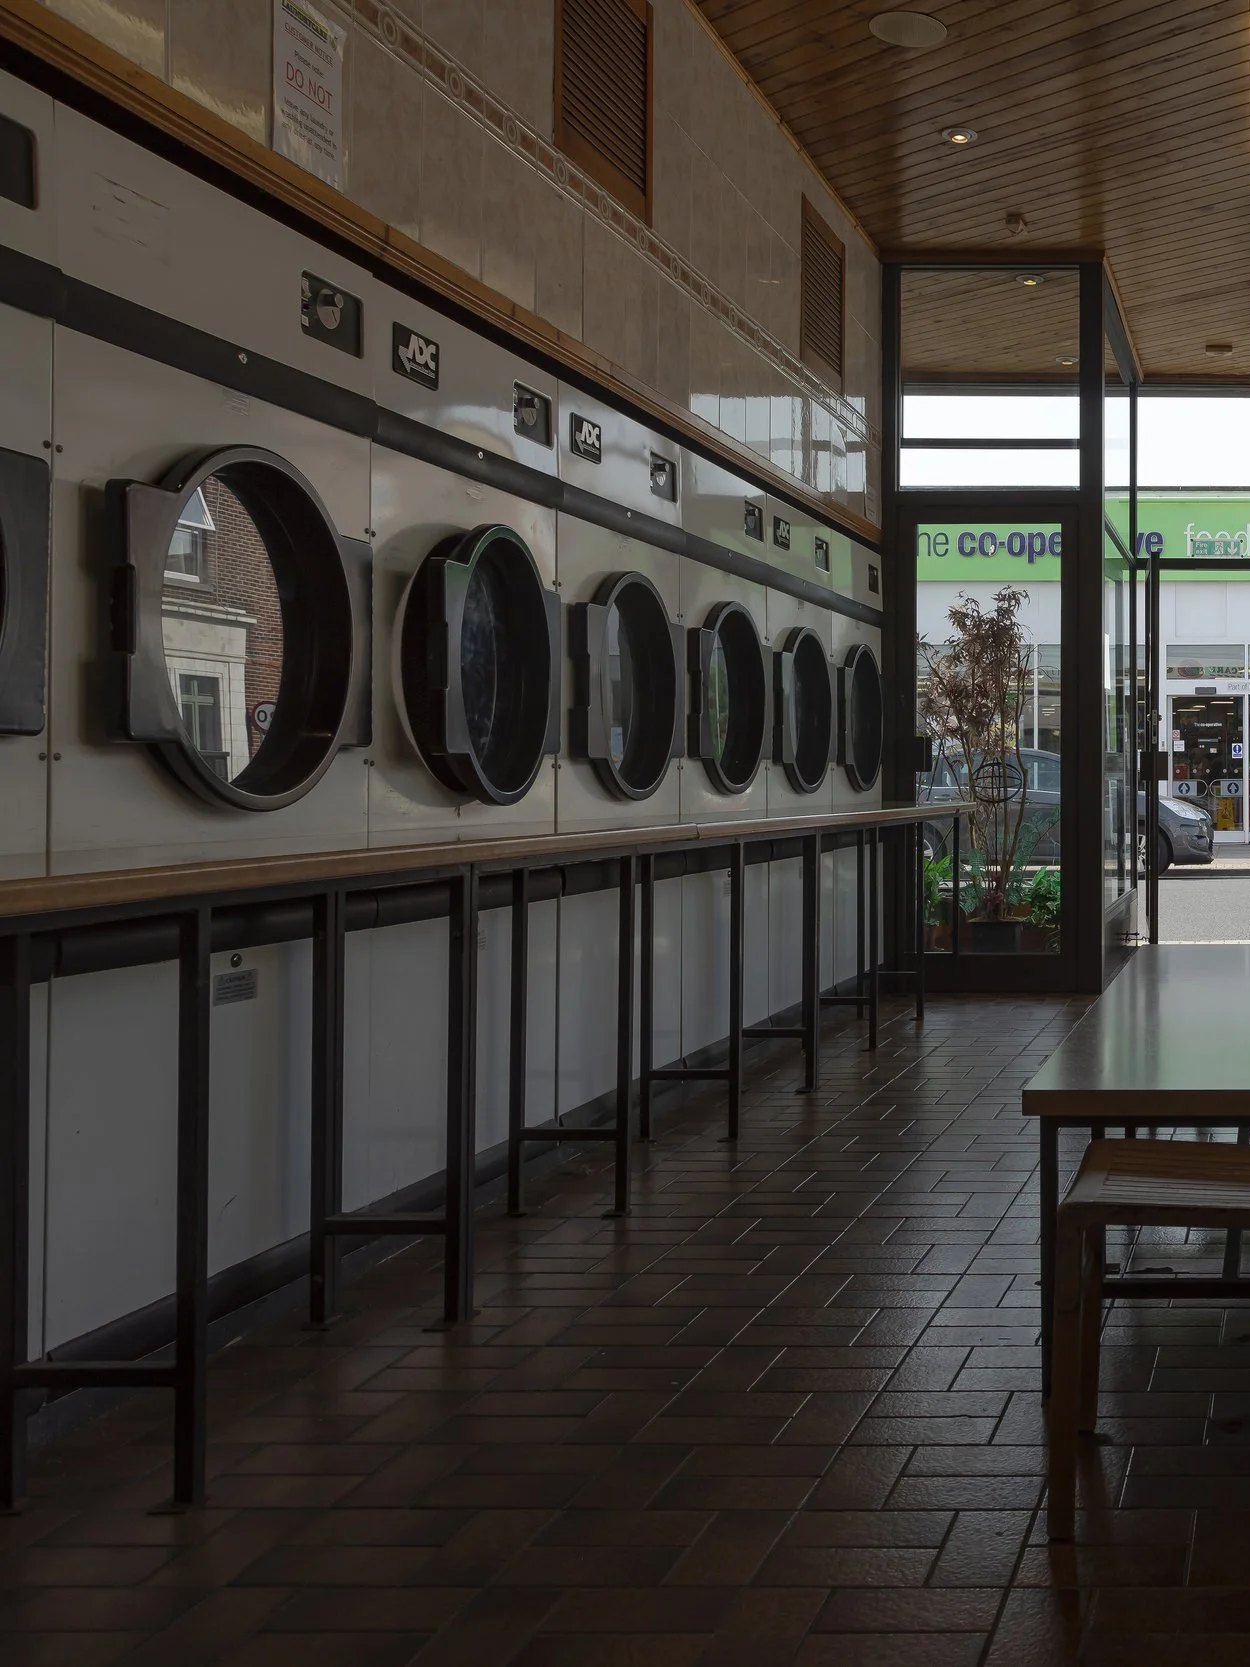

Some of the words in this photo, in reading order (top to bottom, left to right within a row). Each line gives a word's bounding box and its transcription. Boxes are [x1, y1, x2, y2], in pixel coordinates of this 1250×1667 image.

[285, 22, 314, 50] CUSTOMER
[315, 45, 333, 64] NOTICE
[286, 61, 304, 89] DO
[309, 76, 333, 109] NOT
[406, 333, 436, 371] ADC
[580, 421, 601, 448] ADC
[1228, 683, 1240, 692] Part
[1242, 683, 1248, 691] of
